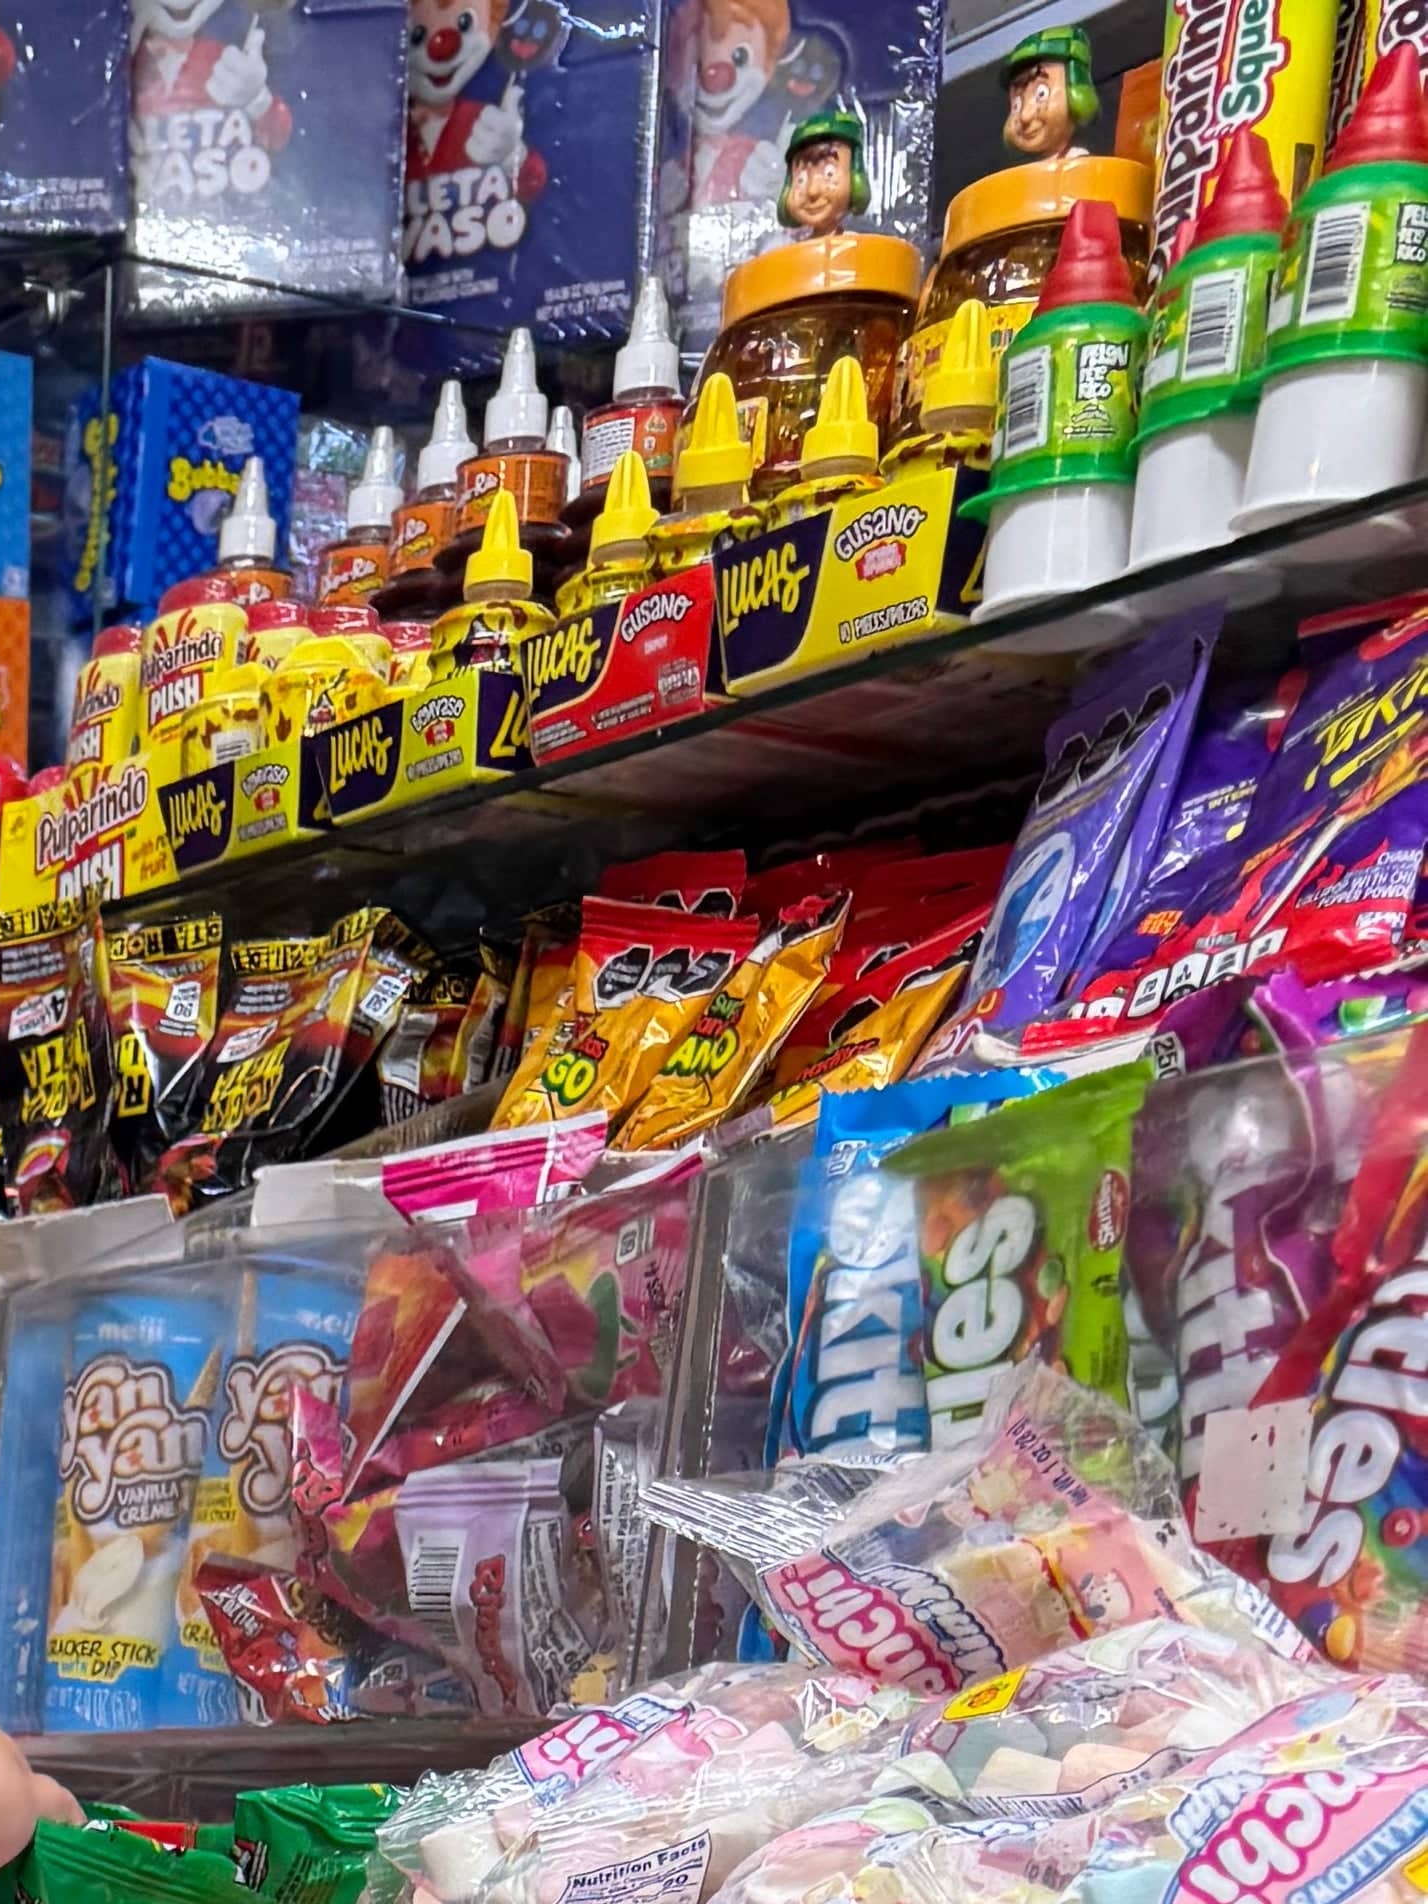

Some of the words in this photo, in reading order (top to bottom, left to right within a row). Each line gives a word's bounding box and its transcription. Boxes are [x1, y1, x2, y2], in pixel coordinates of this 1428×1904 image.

[720, 542, 810, 638] LUCAS
[523, 616, 604, 701] LUCAS
[149, 674, 201, 726] PUSH
[329, 716, 393, 795] LUCAS
[34, 765, 150, 877] Pulparindo
[167, 780, 227, 848] LUCAS
[97, 1320, 166, 1344] meiji
[115, 1480, 181, 1507] VANILLA
[117, 1504, 177, 1527] CREME
[109, 1641, 156, 1665] STICK
[570, 1856, 653, 1892] Nutrition
[656, 1836, 709, 1867] Facts
